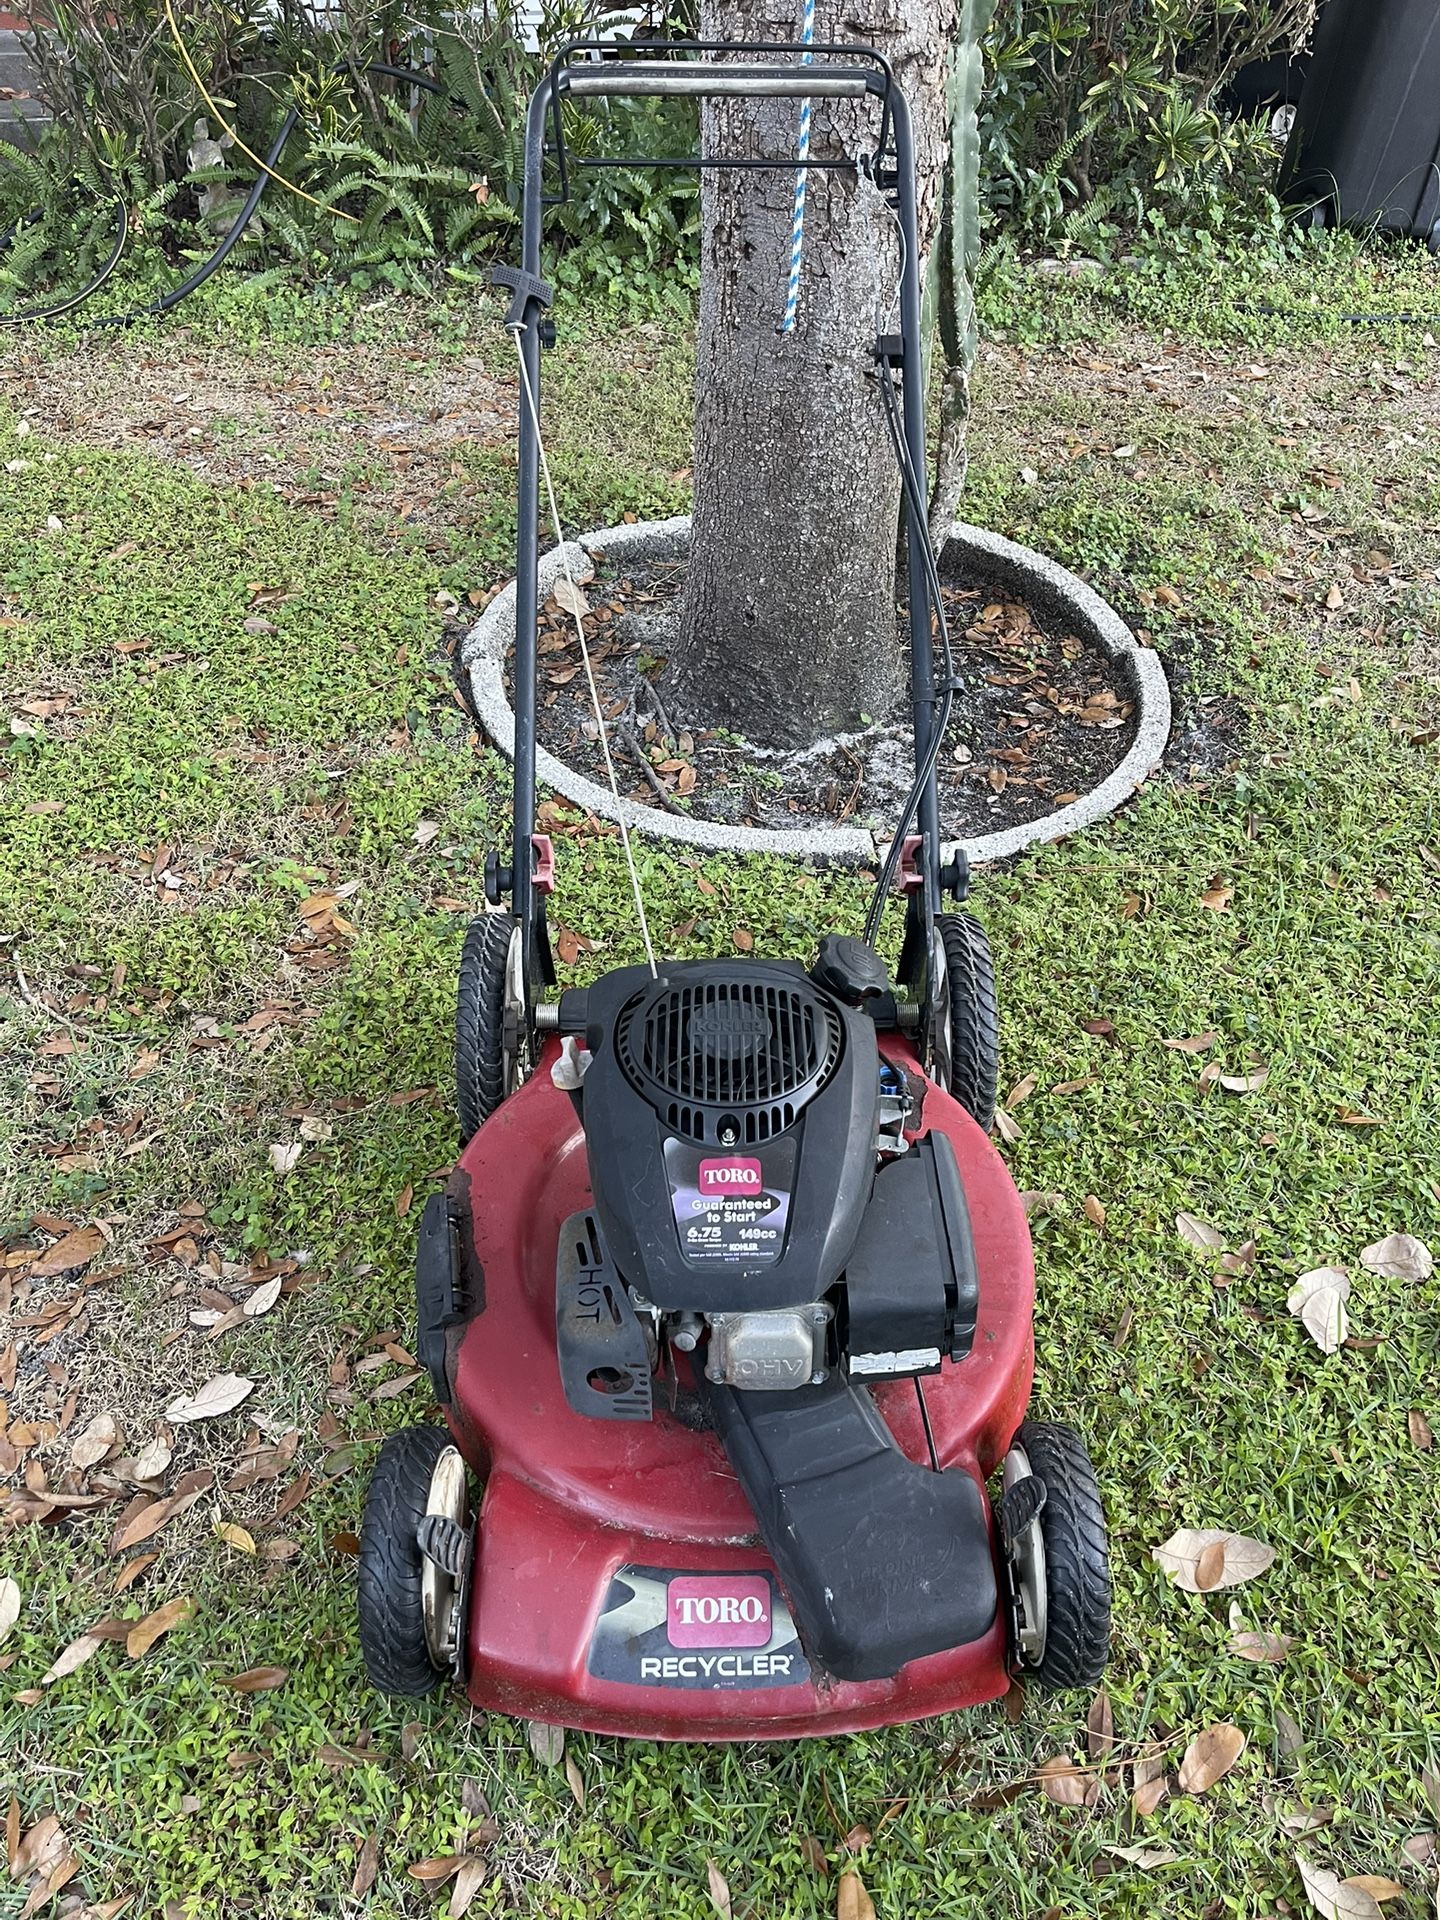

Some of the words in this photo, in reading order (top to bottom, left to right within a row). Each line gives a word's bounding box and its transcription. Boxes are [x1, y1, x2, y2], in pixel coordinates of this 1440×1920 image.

[695, 1020, 762, 1033] KOHLER
[704, 1168, 757, 1185] TORO
[691, 1198, 772, 1211] Guaranteed
[706, 1212, 721, 1223] to
[723, 1211, 757, 1223] Start
[687, 1226, 722, 1238] 6.75
[738, 1228, 777, 1239] 149cc
[729, 1242, 759, 1251] KOHLER
[576, 1269, 603, 1323] HOT
[737, 1359, 804, 1377] OHV
[675, 1596, 764, 1624] TORO
[641, 1654, 792, 1678] RECYCLER
